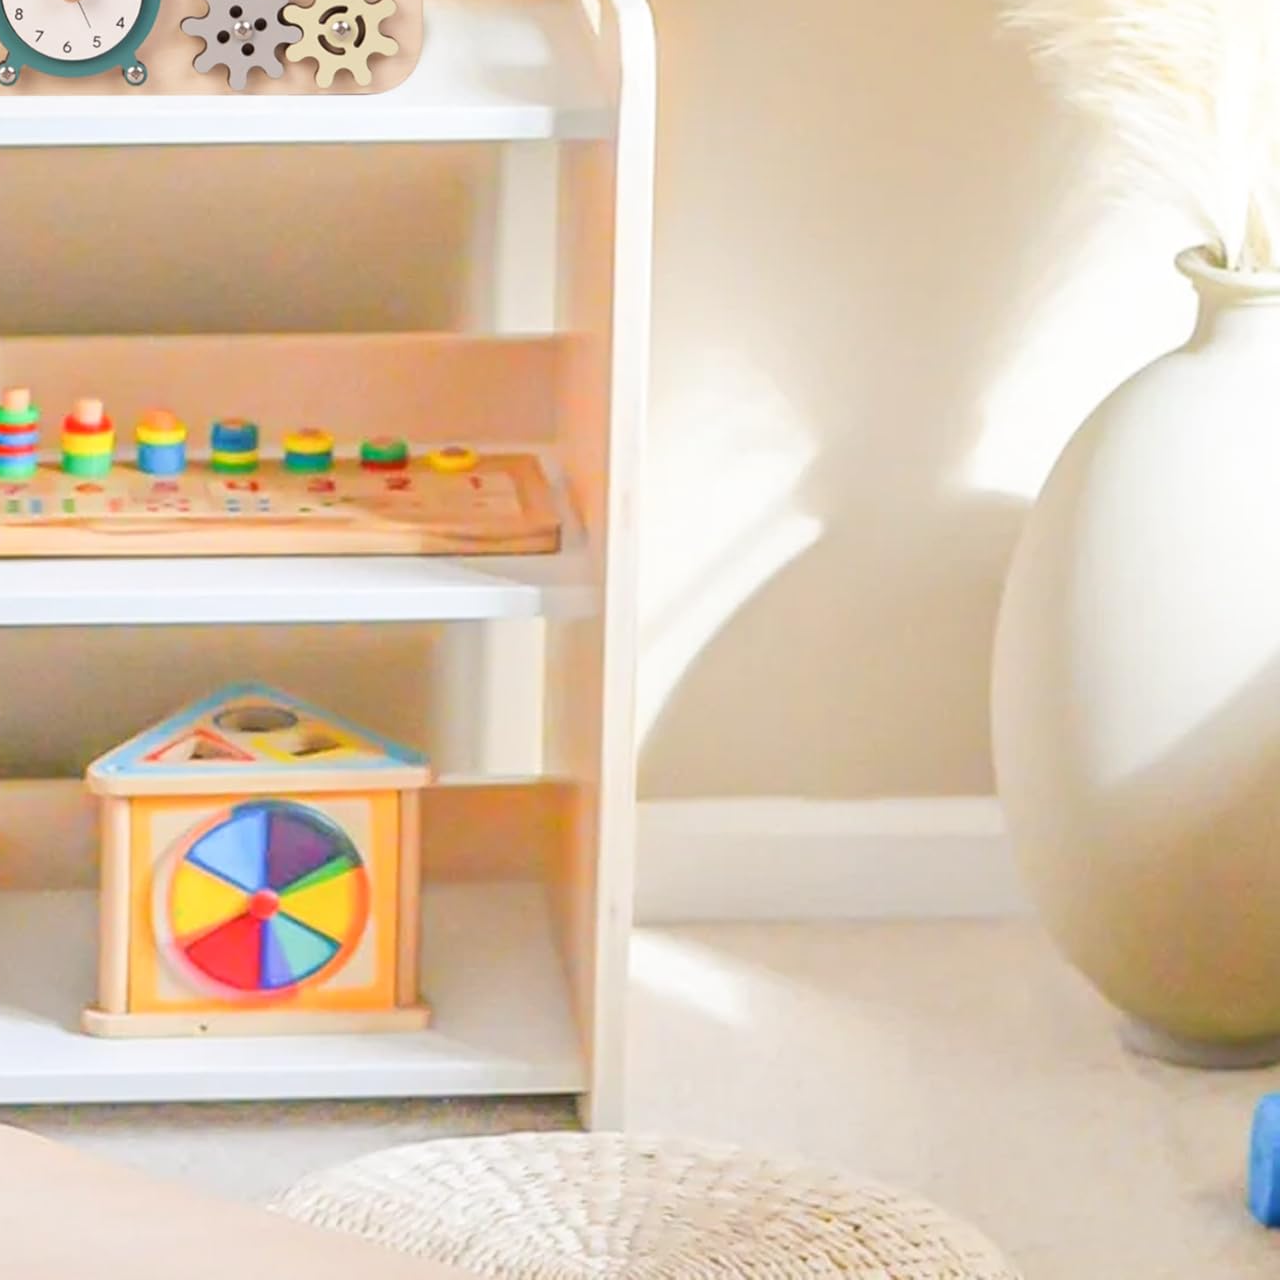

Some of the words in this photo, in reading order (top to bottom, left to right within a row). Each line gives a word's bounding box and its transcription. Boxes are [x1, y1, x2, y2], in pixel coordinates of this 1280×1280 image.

[14, 8, 24, 21] 8
[115, 16, 125, 29] 4
[34, 29, 45, 42] 7
[92, 35, 101, 48] 5
[62, 40, 72, 53] 6
